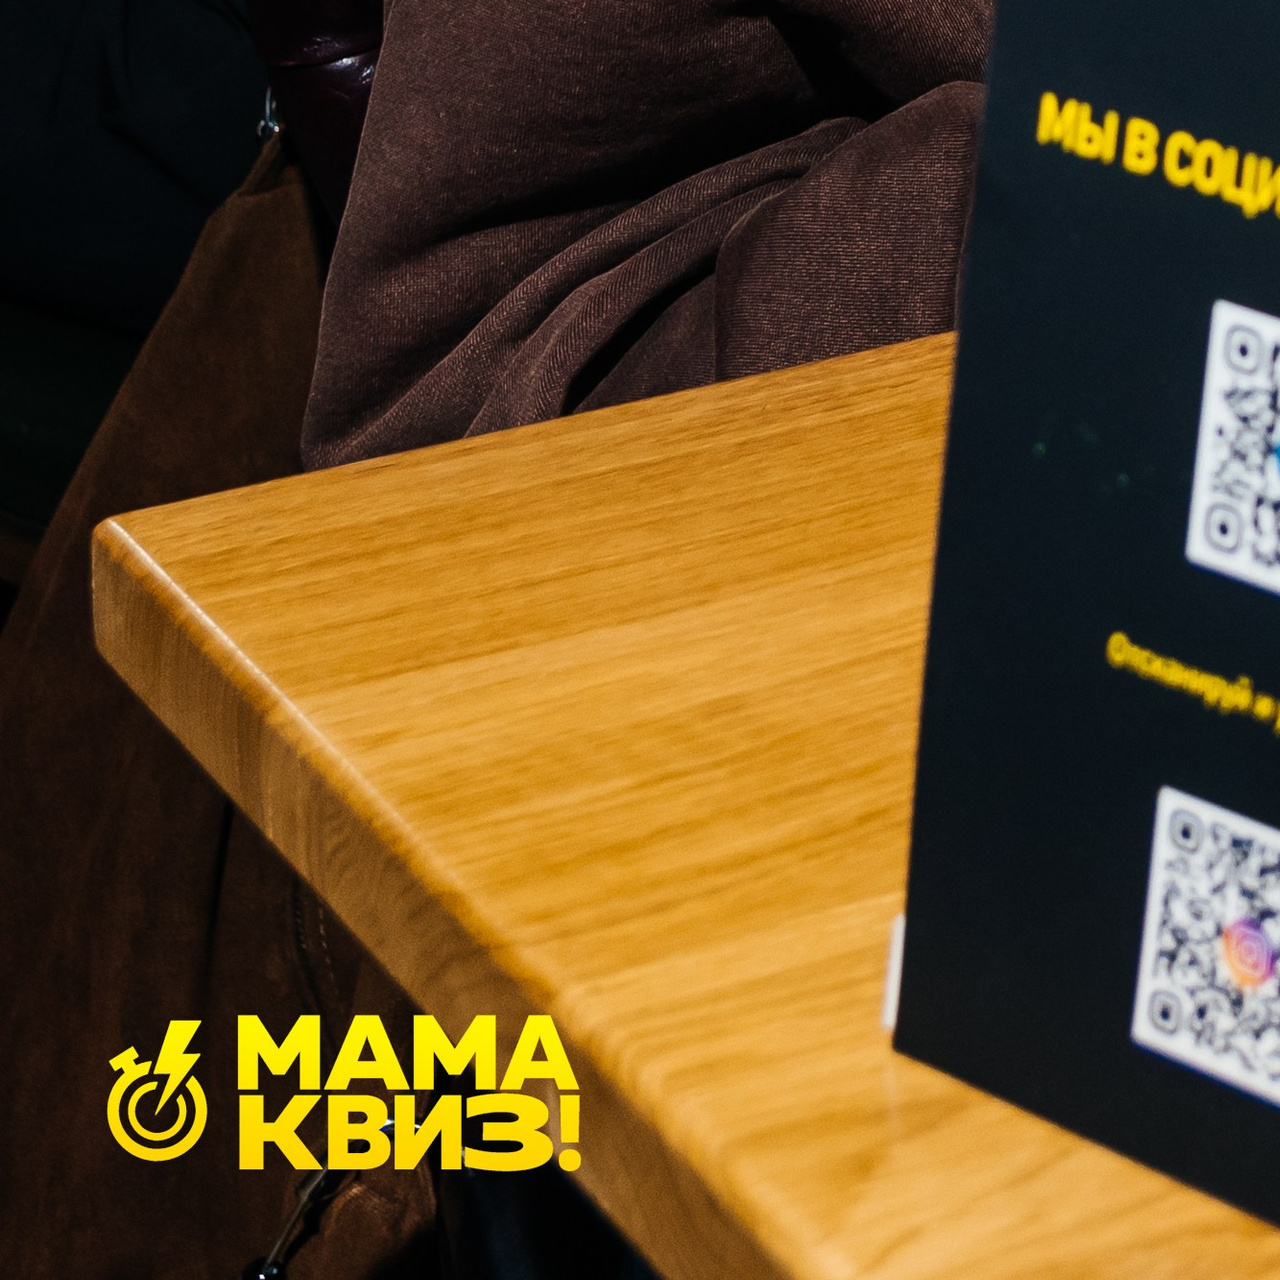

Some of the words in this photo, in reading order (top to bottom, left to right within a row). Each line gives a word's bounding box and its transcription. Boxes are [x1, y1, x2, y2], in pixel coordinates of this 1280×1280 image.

[1036, 92, 1119, 164] МЫ
[1121, 116, 1160, 175] В
[1106, 631, 1252, 714] Отсканируй
[1253, 694, 1275, 721] и
